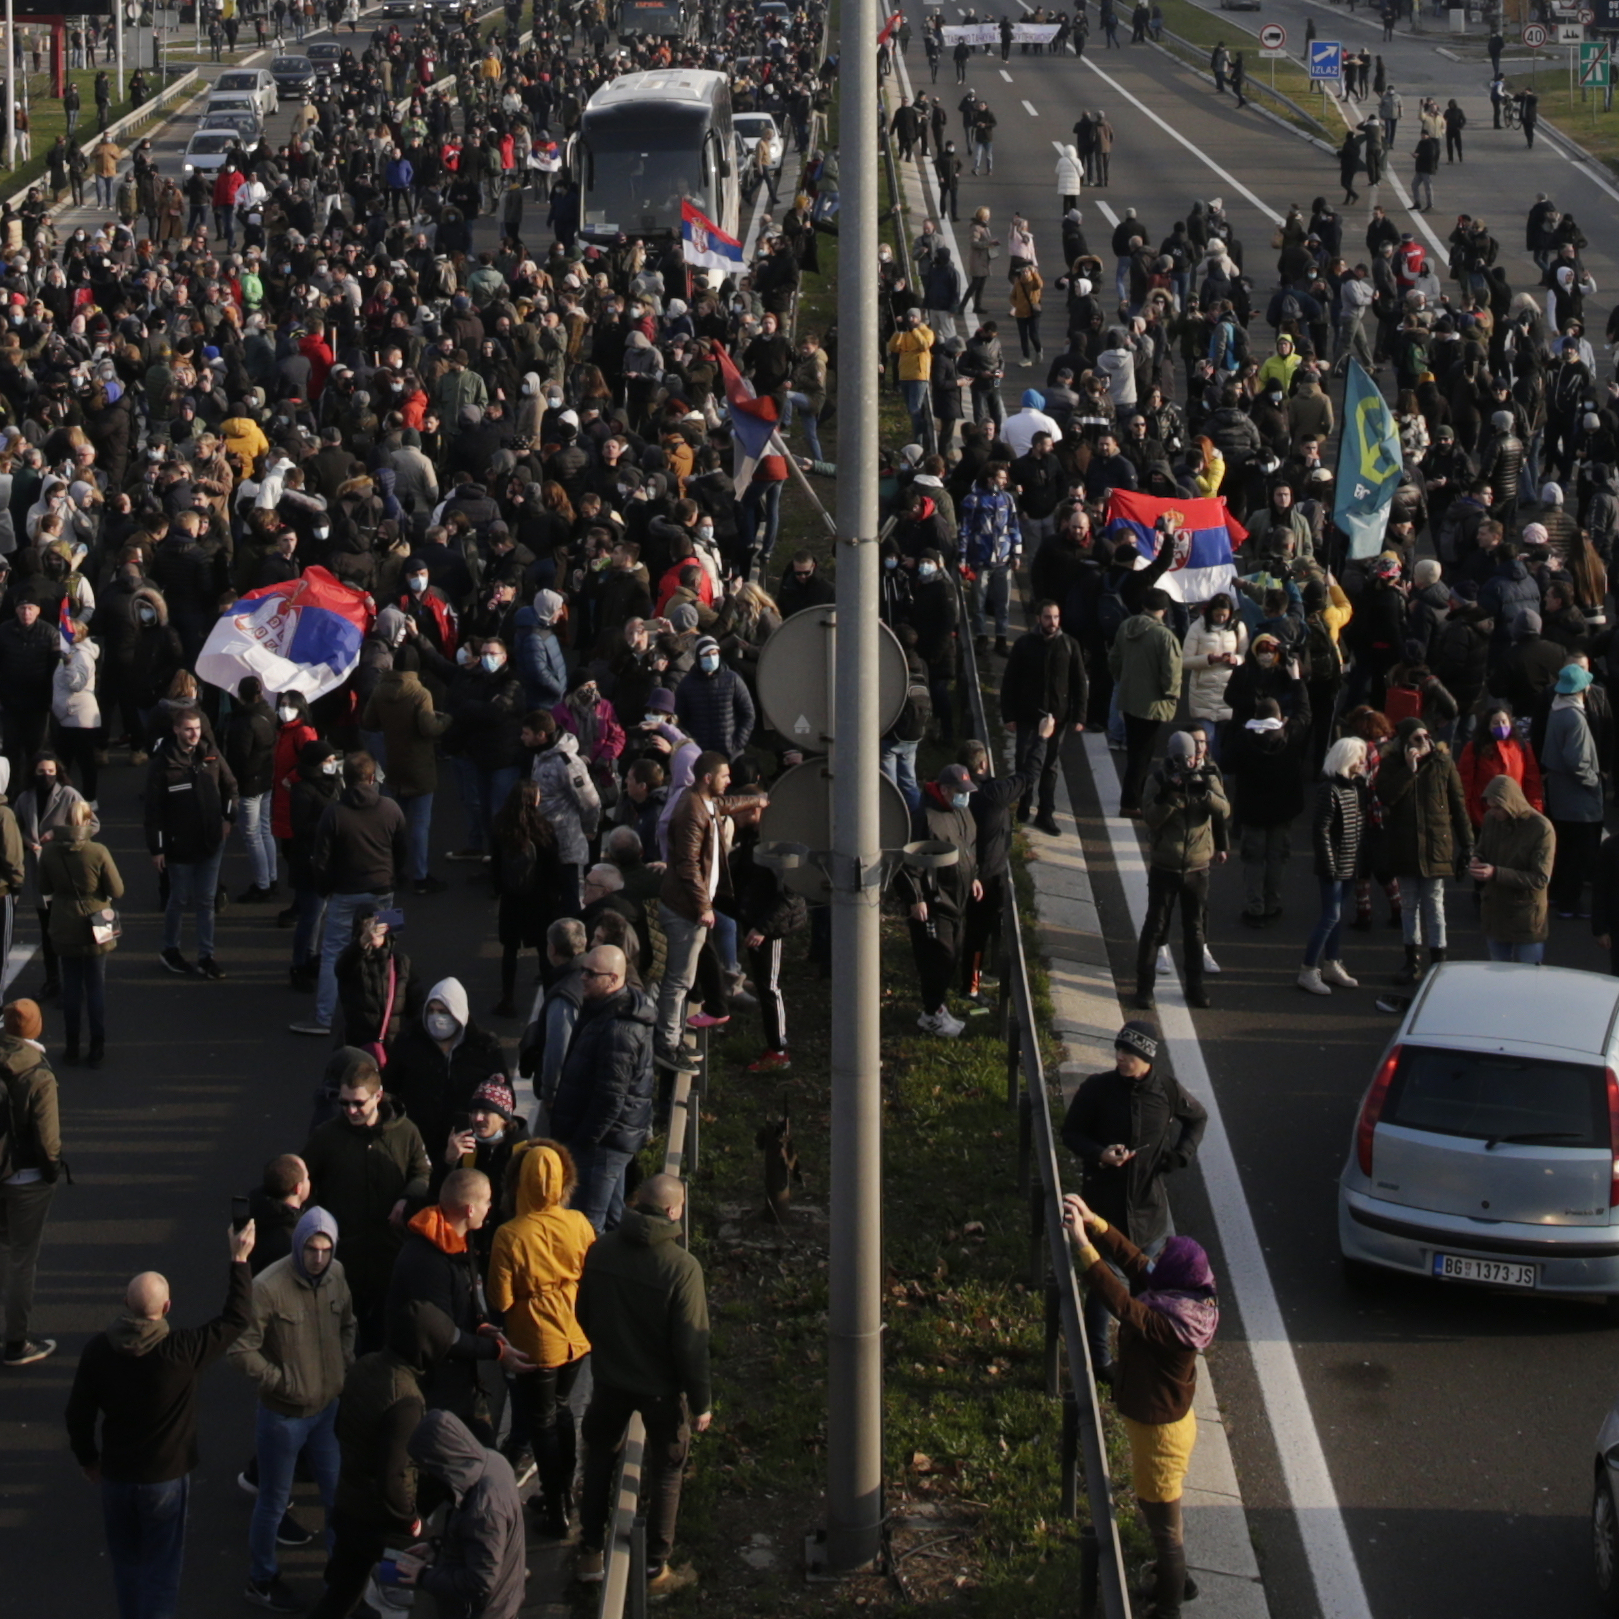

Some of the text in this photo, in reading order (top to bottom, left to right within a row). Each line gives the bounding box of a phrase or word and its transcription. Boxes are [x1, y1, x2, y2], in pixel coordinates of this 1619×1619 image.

[1526, 30, 1542, 43] 40
[1312, 66, 1338, 75] IZLAZ
[1445, 1257, 1463, 1275] BG
